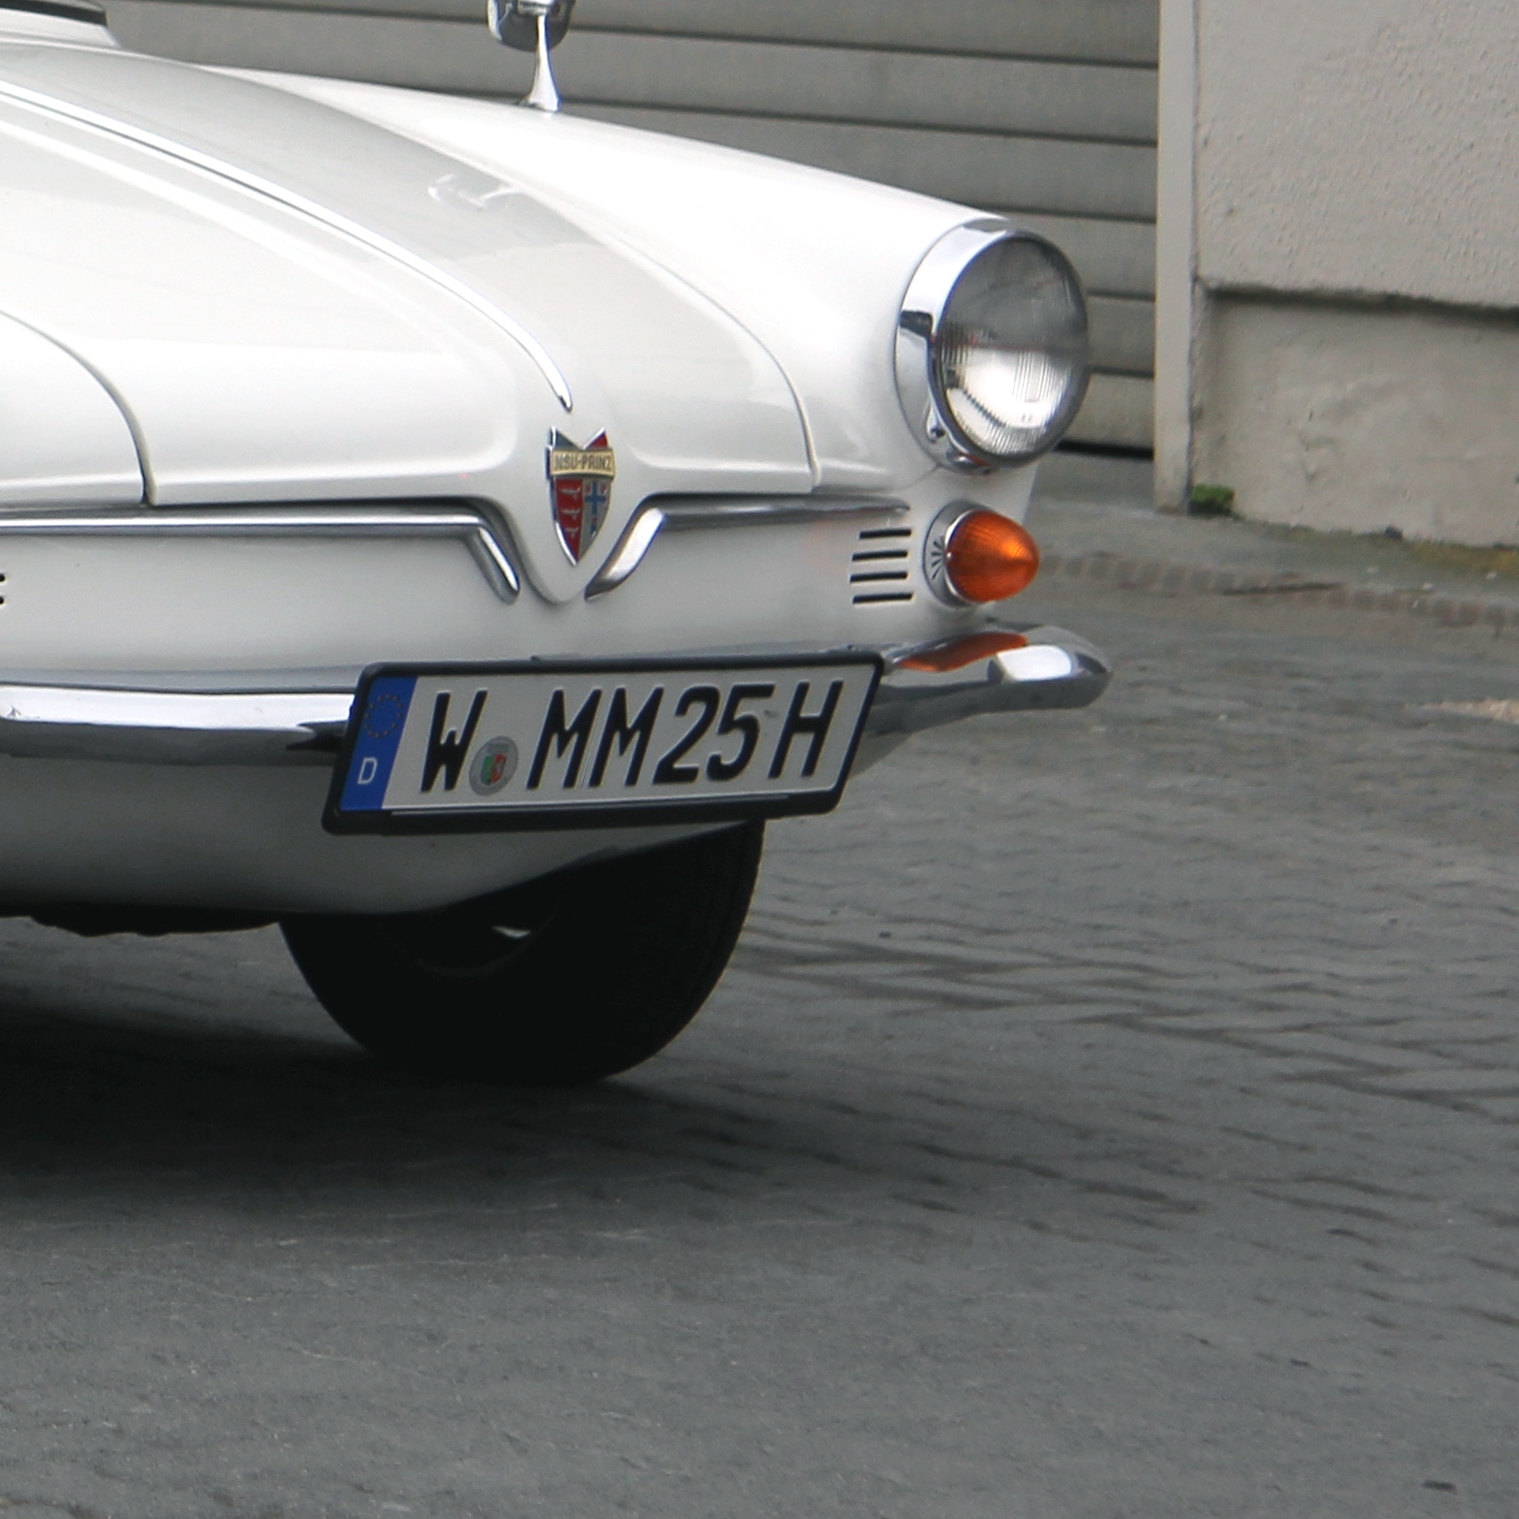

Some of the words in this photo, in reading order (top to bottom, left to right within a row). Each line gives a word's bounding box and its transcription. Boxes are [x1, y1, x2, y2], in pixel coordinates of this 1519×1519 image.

[555, 452, 612, 471] NSU-PRINZ
[419, 689, 489, 794] W
[526, 679, 845, 790] MM25H
[356, 757, 378, 785] D
